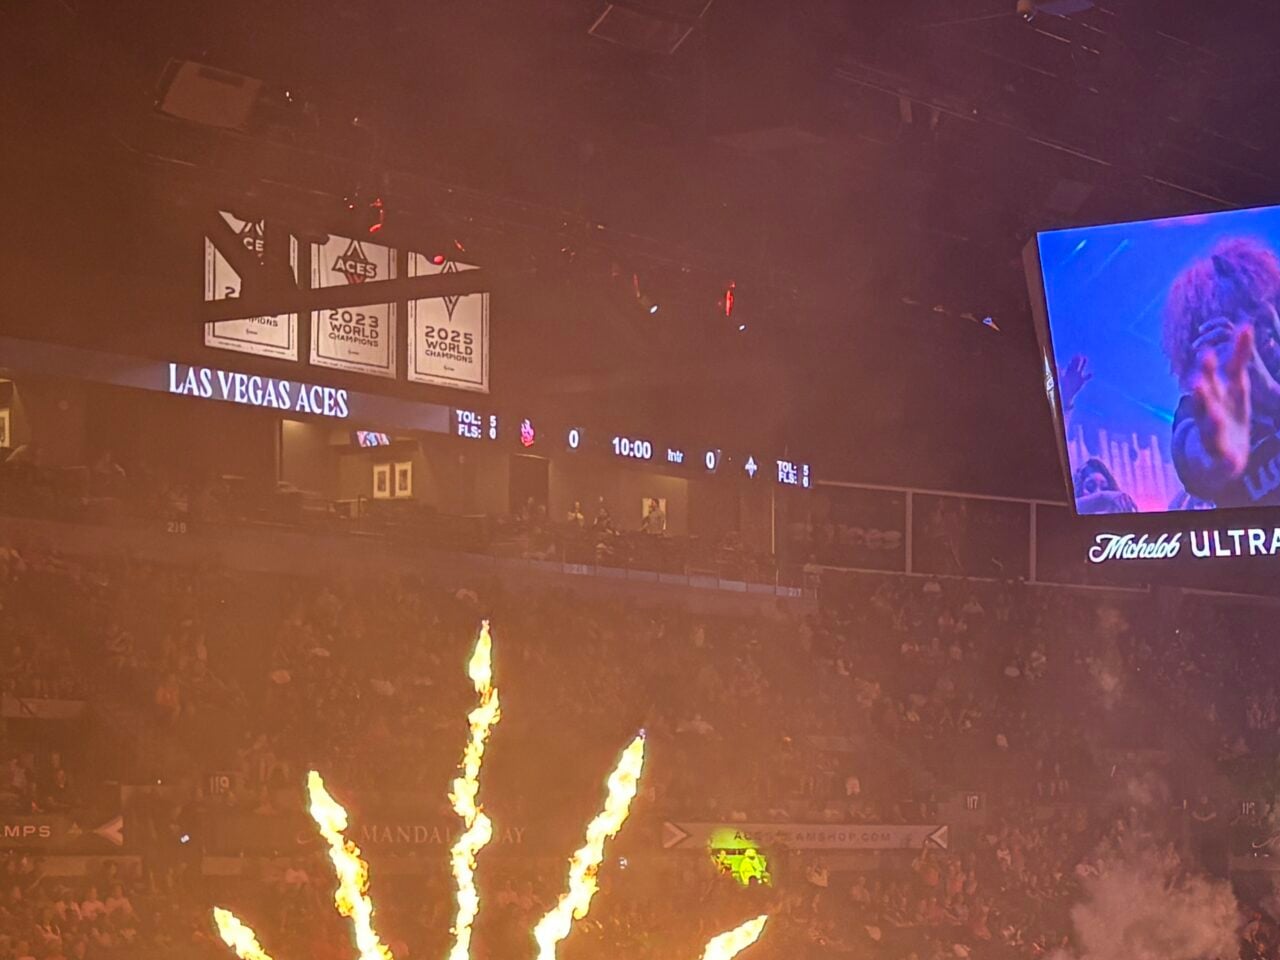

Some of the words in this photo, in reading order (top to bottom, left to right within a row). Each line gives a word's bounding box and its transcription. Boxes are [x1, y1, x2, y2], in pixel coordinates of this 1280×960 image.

[335, 258, 376, 278] ACES
[329, 308, 379, 329] 2023
[330, 321, 379, 339] WORLD
[425, 325, 473, 345] 2025
[328, 332, 379, 348] CHAMPIONS
[426, 338, 473, 356] WORLD
[425, 349, 473, 364] CHAMPIONS
[169, 363, 213, 398] LAS
[217, 370, 291, 410] VEGAS
[296, 383, 348, 418] ACES
[456, 409, 481, 425] TOL:
[490, 415, 497, 427] 5
[458, 424, 481, 438] FLS:
[568, 429, 579, 448] 0
[612, 437, 651, 459] 10:00
[706, 451, 715, 469] 0
[776, 460, 797, 474] TOL:
[778, 471, 797, 485] FLS:
[1089, 532, 1182, 563] Michelob
[0, 824, 51, 839] MPS
